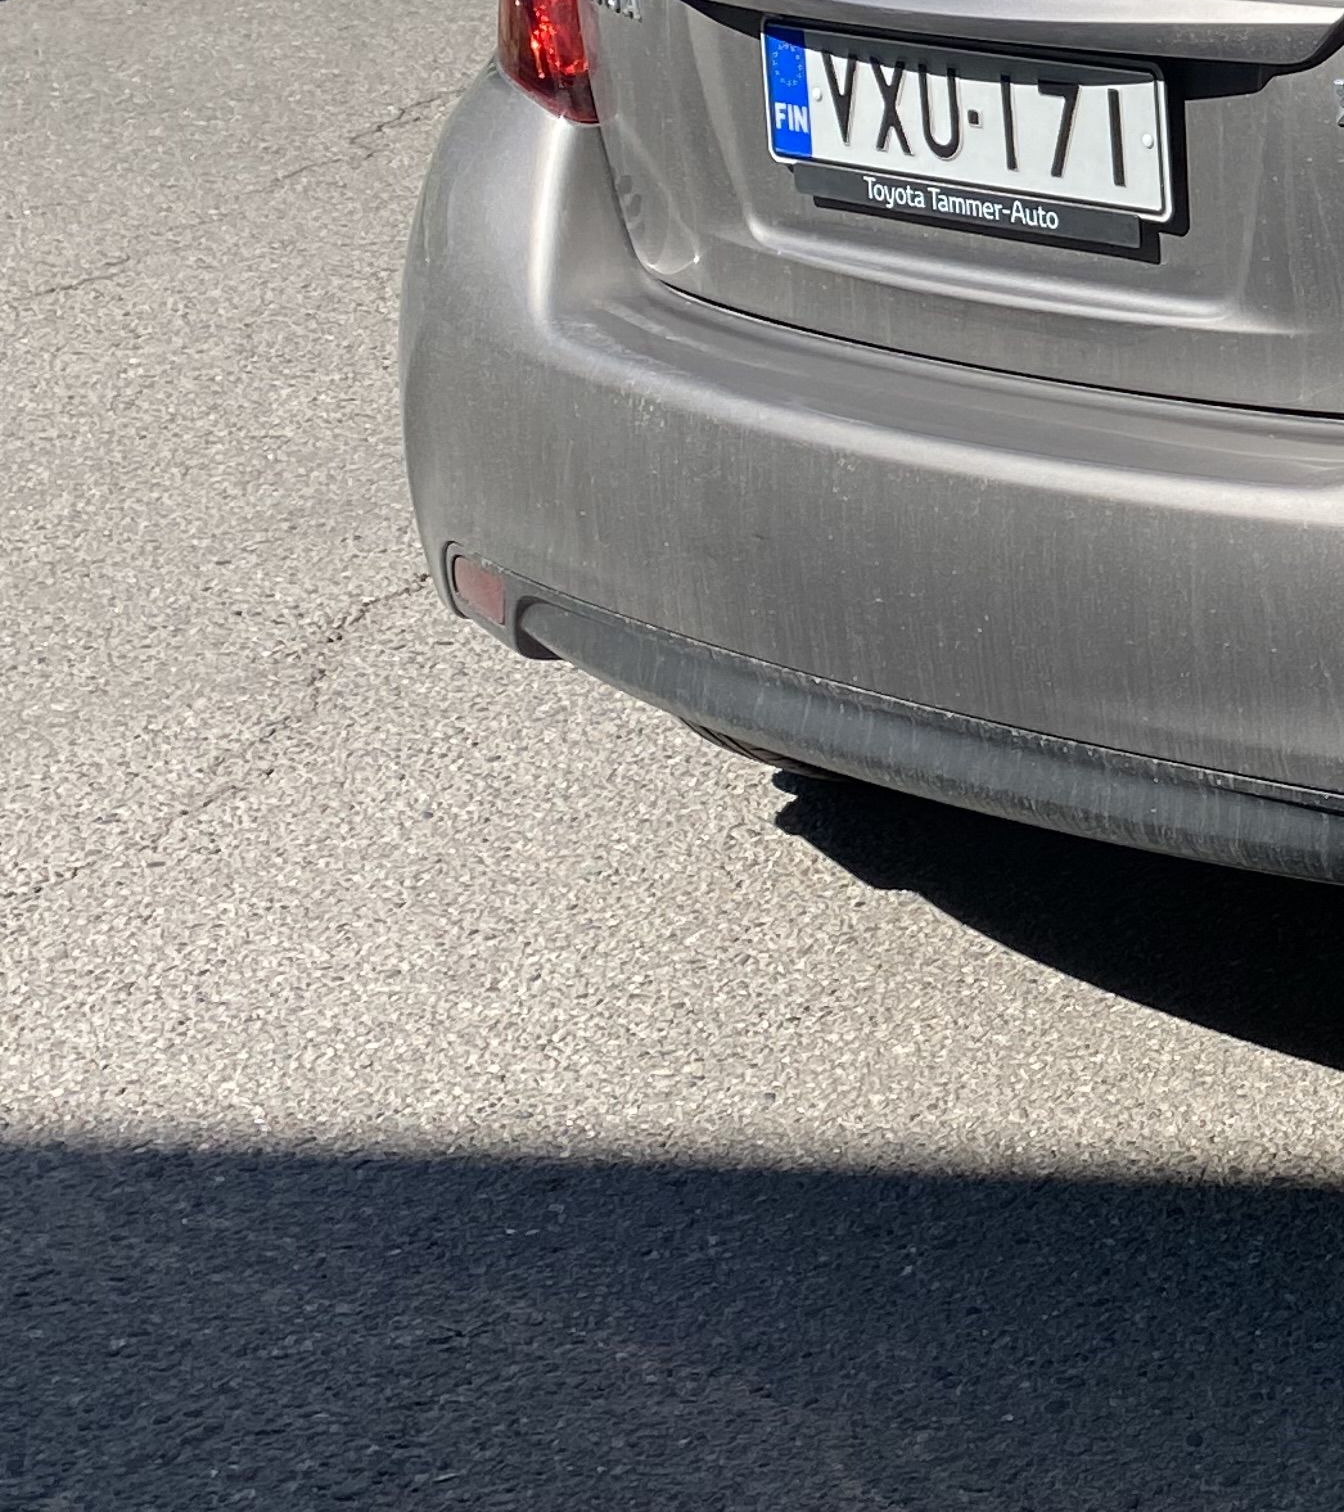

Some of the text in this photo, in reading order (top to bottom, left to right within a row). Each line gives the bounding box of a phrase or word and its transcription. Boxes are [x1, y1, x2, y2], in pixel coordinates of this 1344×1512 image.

[774, 101, 810, 135] FIN
[821, 47, 1128, 188] VXU-171
[863, 175, 1060, 230] Toyota Tammer-Auto
